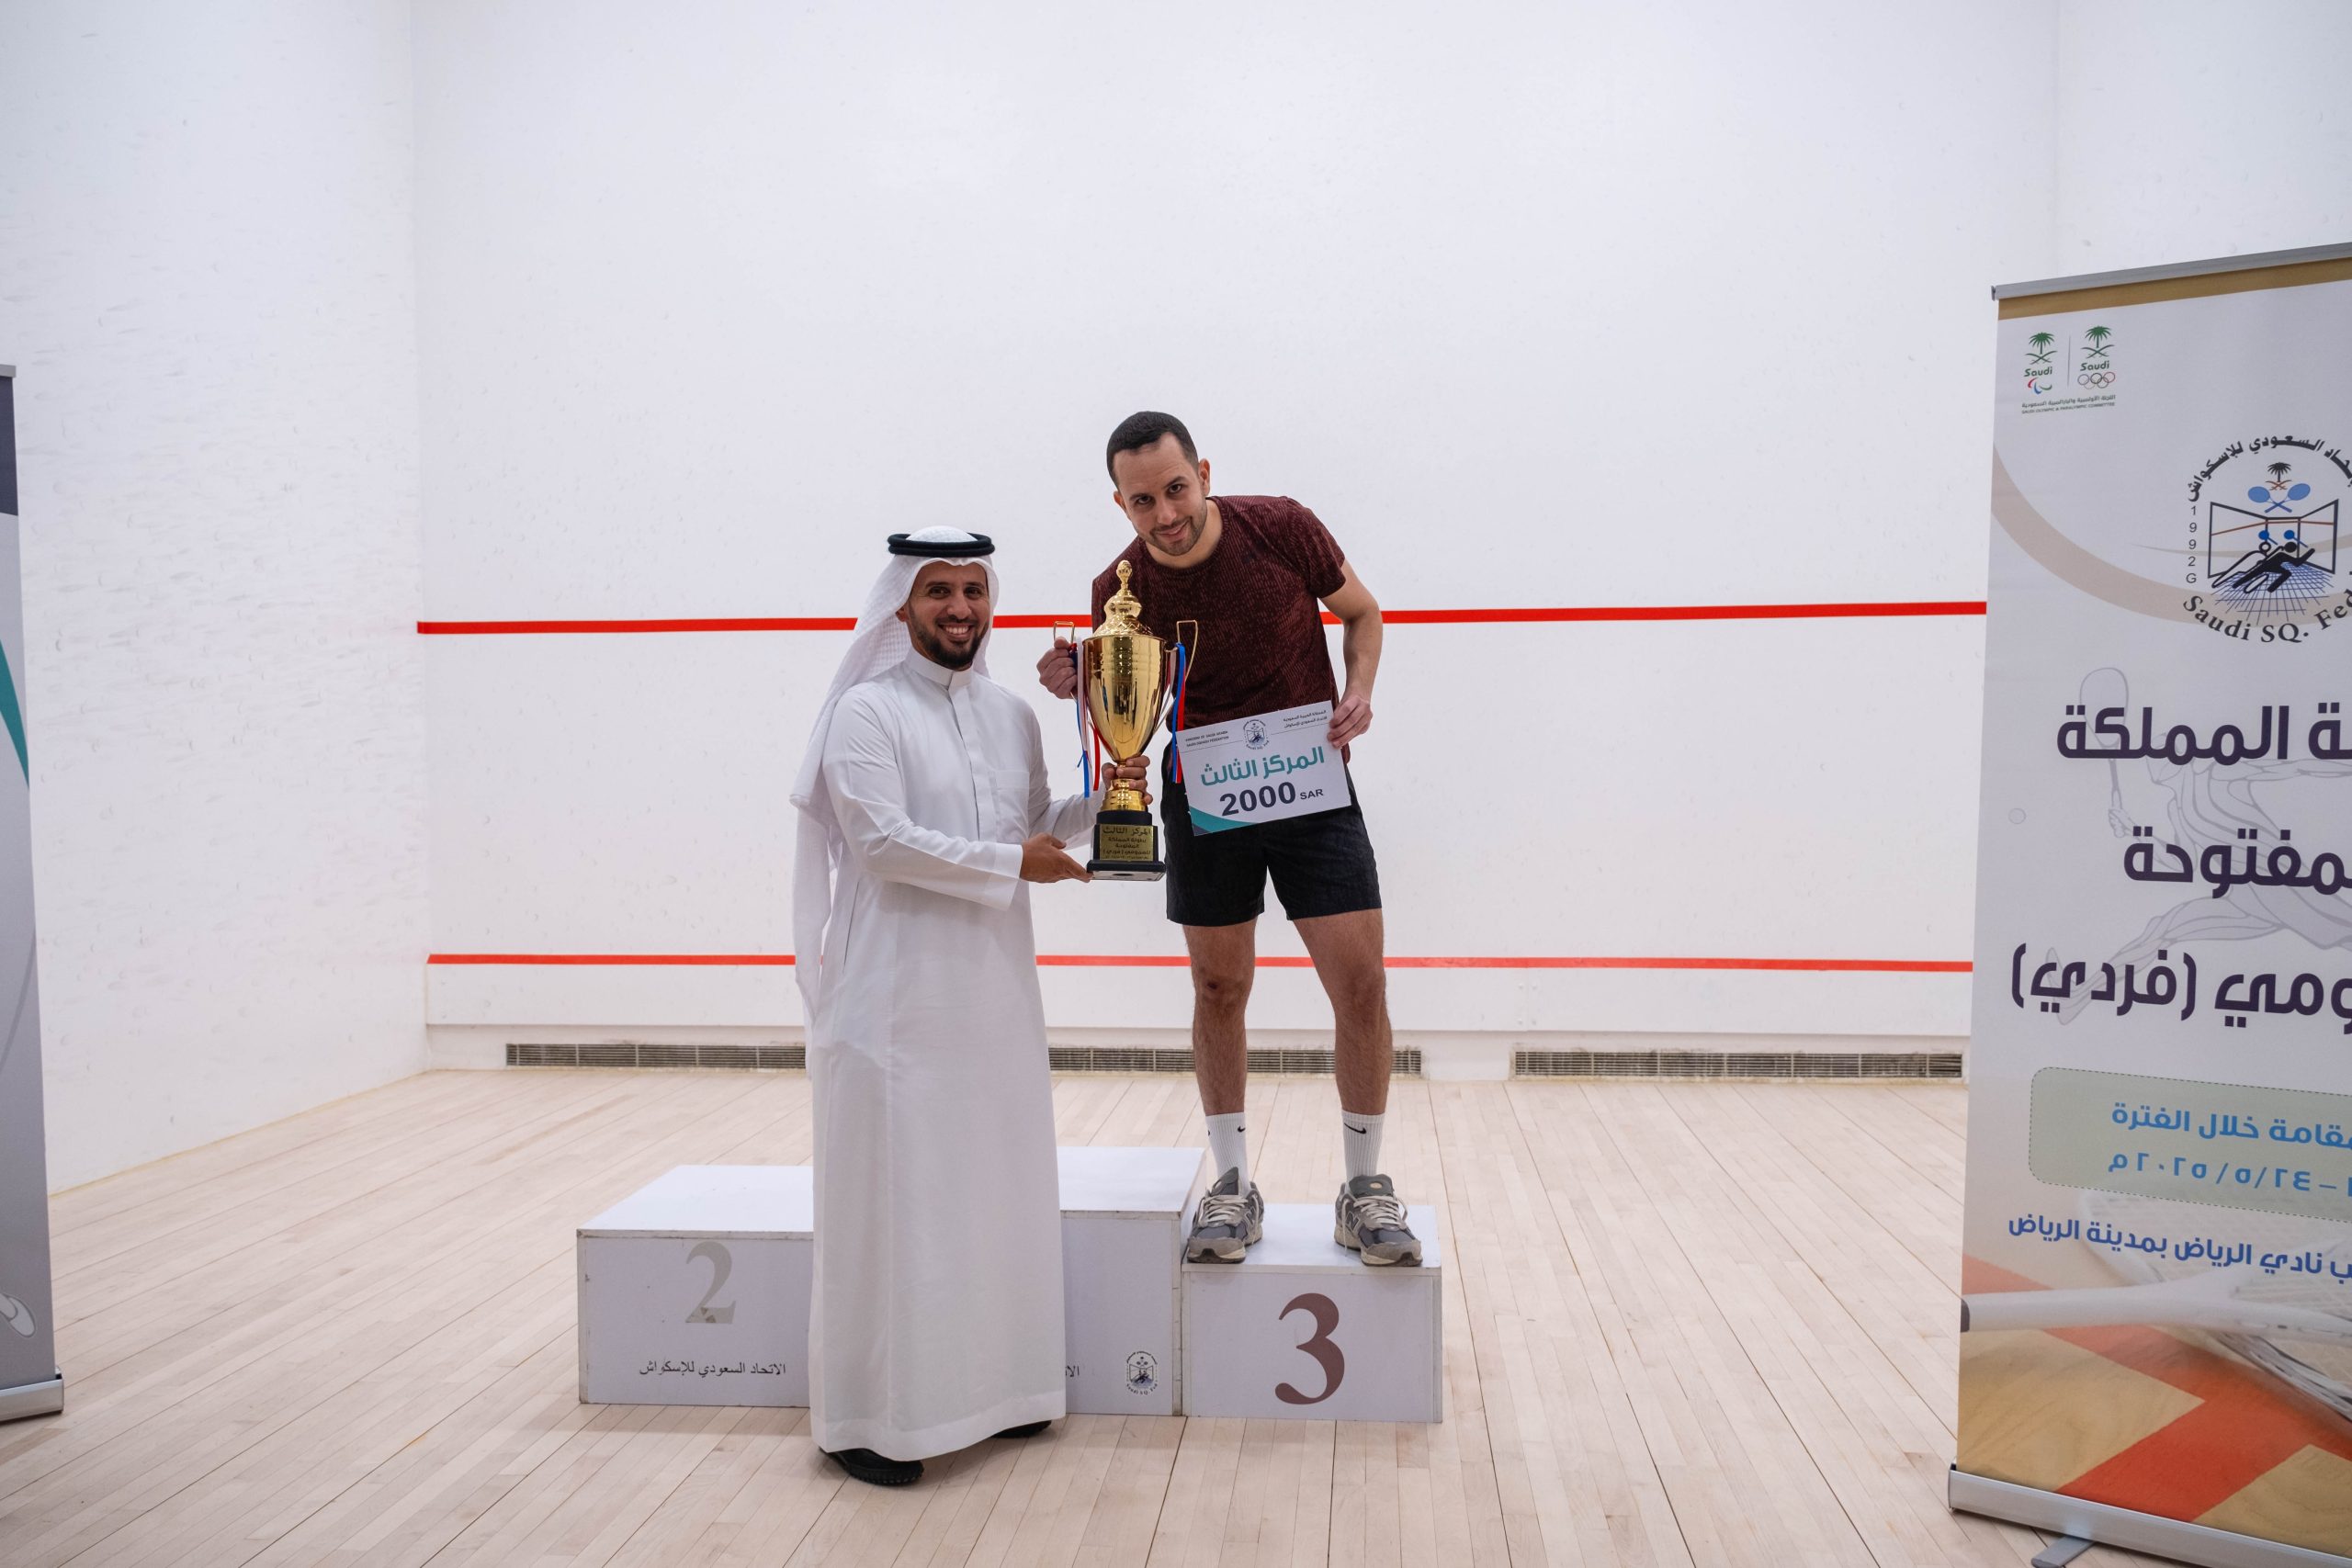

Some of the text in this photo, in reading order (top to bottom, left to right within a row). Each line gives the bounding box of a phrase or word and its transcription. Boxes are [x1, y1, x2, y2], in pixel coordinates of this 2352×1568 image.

[2024, 367, 2053, 378] Saudi
[2079, 360, 2110, 372] Saudi
[2248, 434, 2325, 455] السعودي
[2183, 595, 2252, 641] Saudi
[2260, 623, 2309, 643] SQ.
[2057, 705, 2290, 766] المملكة
[1200, 746, 1325, 786] المركز الثالث
[1219, 782, 1324, 817] 2000 SAR
[2111, 1101, 2190, 1133] الفترة
[2199, 1113, 2259, 1140] خلال
[2008, 1213, 2080, 1242] الرياض
[2086, 1222, 2167, 1259] بمدينة
[2174, 1236, 2252, 1268] الرياض
[2259, 1251, 2323, 1275] نادي
[684, 1240, 737, 1325] 2
[1274, 1292, 1345, 1405] 3
[697, 1361, 746, 1379] السعودي
